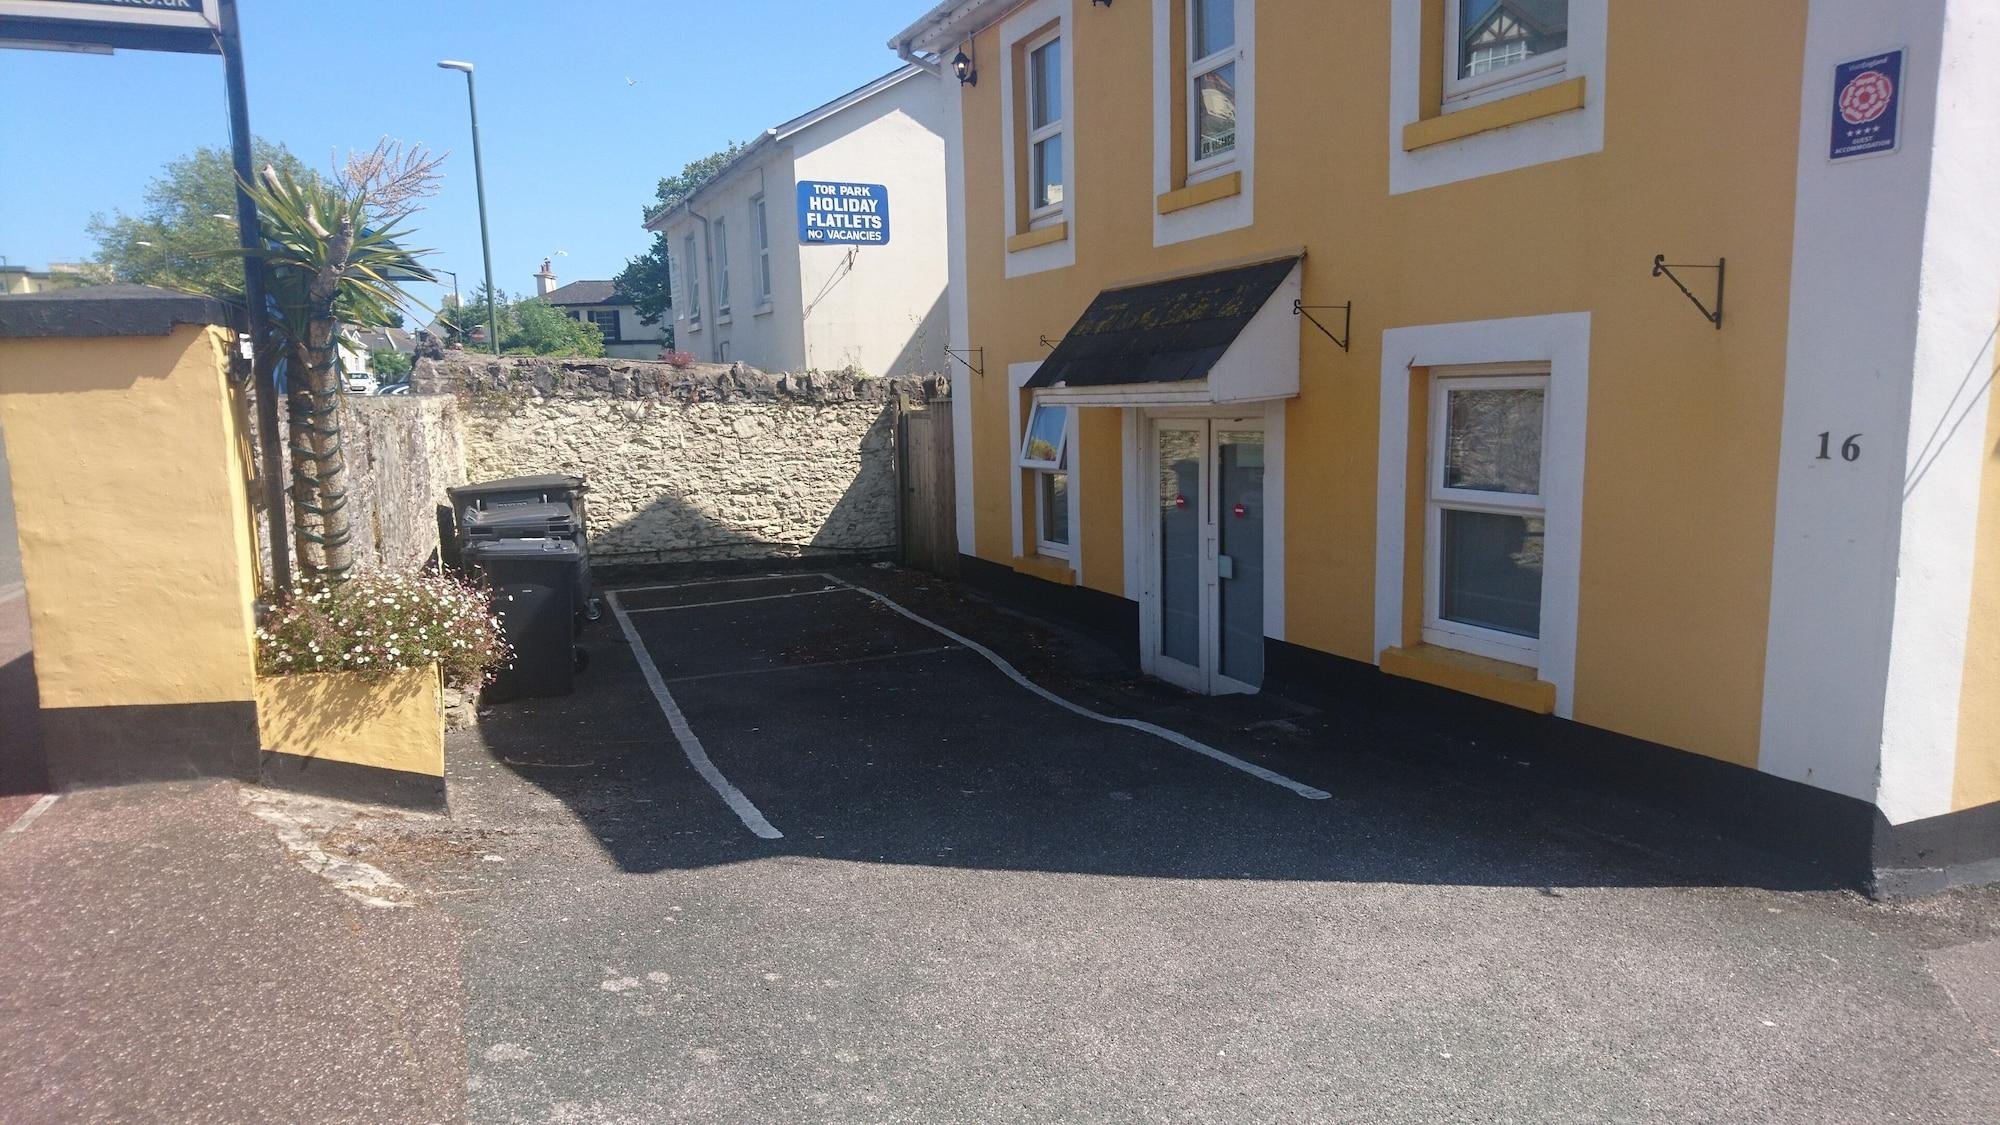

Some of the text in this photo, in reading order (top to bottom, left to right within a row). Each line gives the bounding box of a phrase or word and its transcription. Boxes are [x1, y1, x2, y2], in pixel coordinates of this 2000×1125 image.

[813, 185, 871, 197] TOR PARK
[809, 196, 878, 212] HOLIDAY
[806, 213, 882, 229] FLATLETS
[807, 229, 882, 241] NO VACANCIES
[1815, 431, 1863, 462] 16
